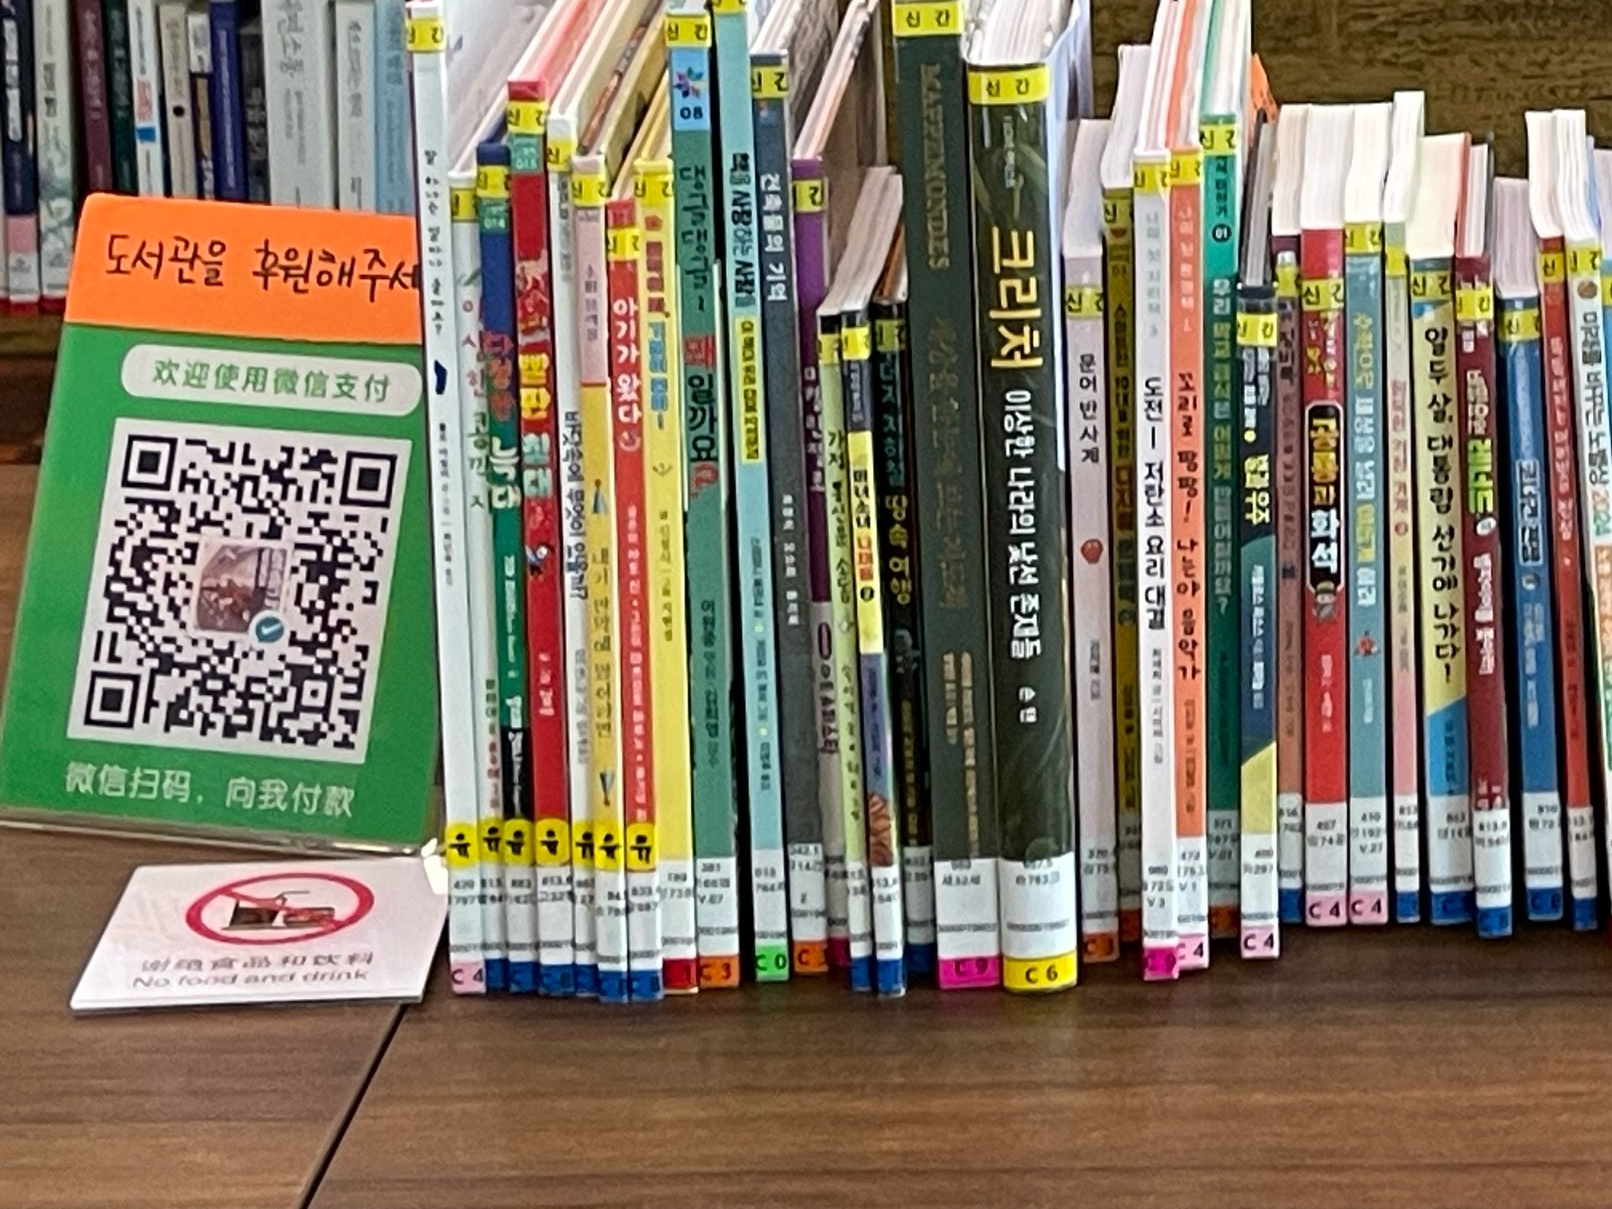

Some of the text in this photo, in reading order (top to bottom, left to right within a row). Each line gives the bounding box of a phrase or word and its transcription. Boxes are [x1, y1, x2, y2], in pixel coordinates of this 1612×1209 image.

[920, 63, 950, 270] MAPPEMONDES
[105, 233, 226, 286] 도서관을
[761, 172, 787, 302] 건축물의 기억
[152, 358, 390, 402] 欢迎使用微信支付
[613, 297, 642, 425] 아기가 왔다
[990, 226, 1043, 659] 크리처 이상한 나라의 낯선 존재들
[1581, 311, 1611, 537] 미래를 바꾸는 노벨상 2024
[1145, 460, 1164, 527] 저탄소
[1245, 491, 1269, 525] 우주
[1427, 435, 1453, 514] 대통령
[1145, 535, 1164, 579] 요리
[1311, 509, 1340, 574] 화석
[1432, 524, 1457, 592] 선거에
[1145, 586, 1165, 629] 대결
[1178, 608, 1199, 680] 음악가
[1433, 603, 1460, 684] 나가다!
[133, 969, 368, 988] No food and drink
